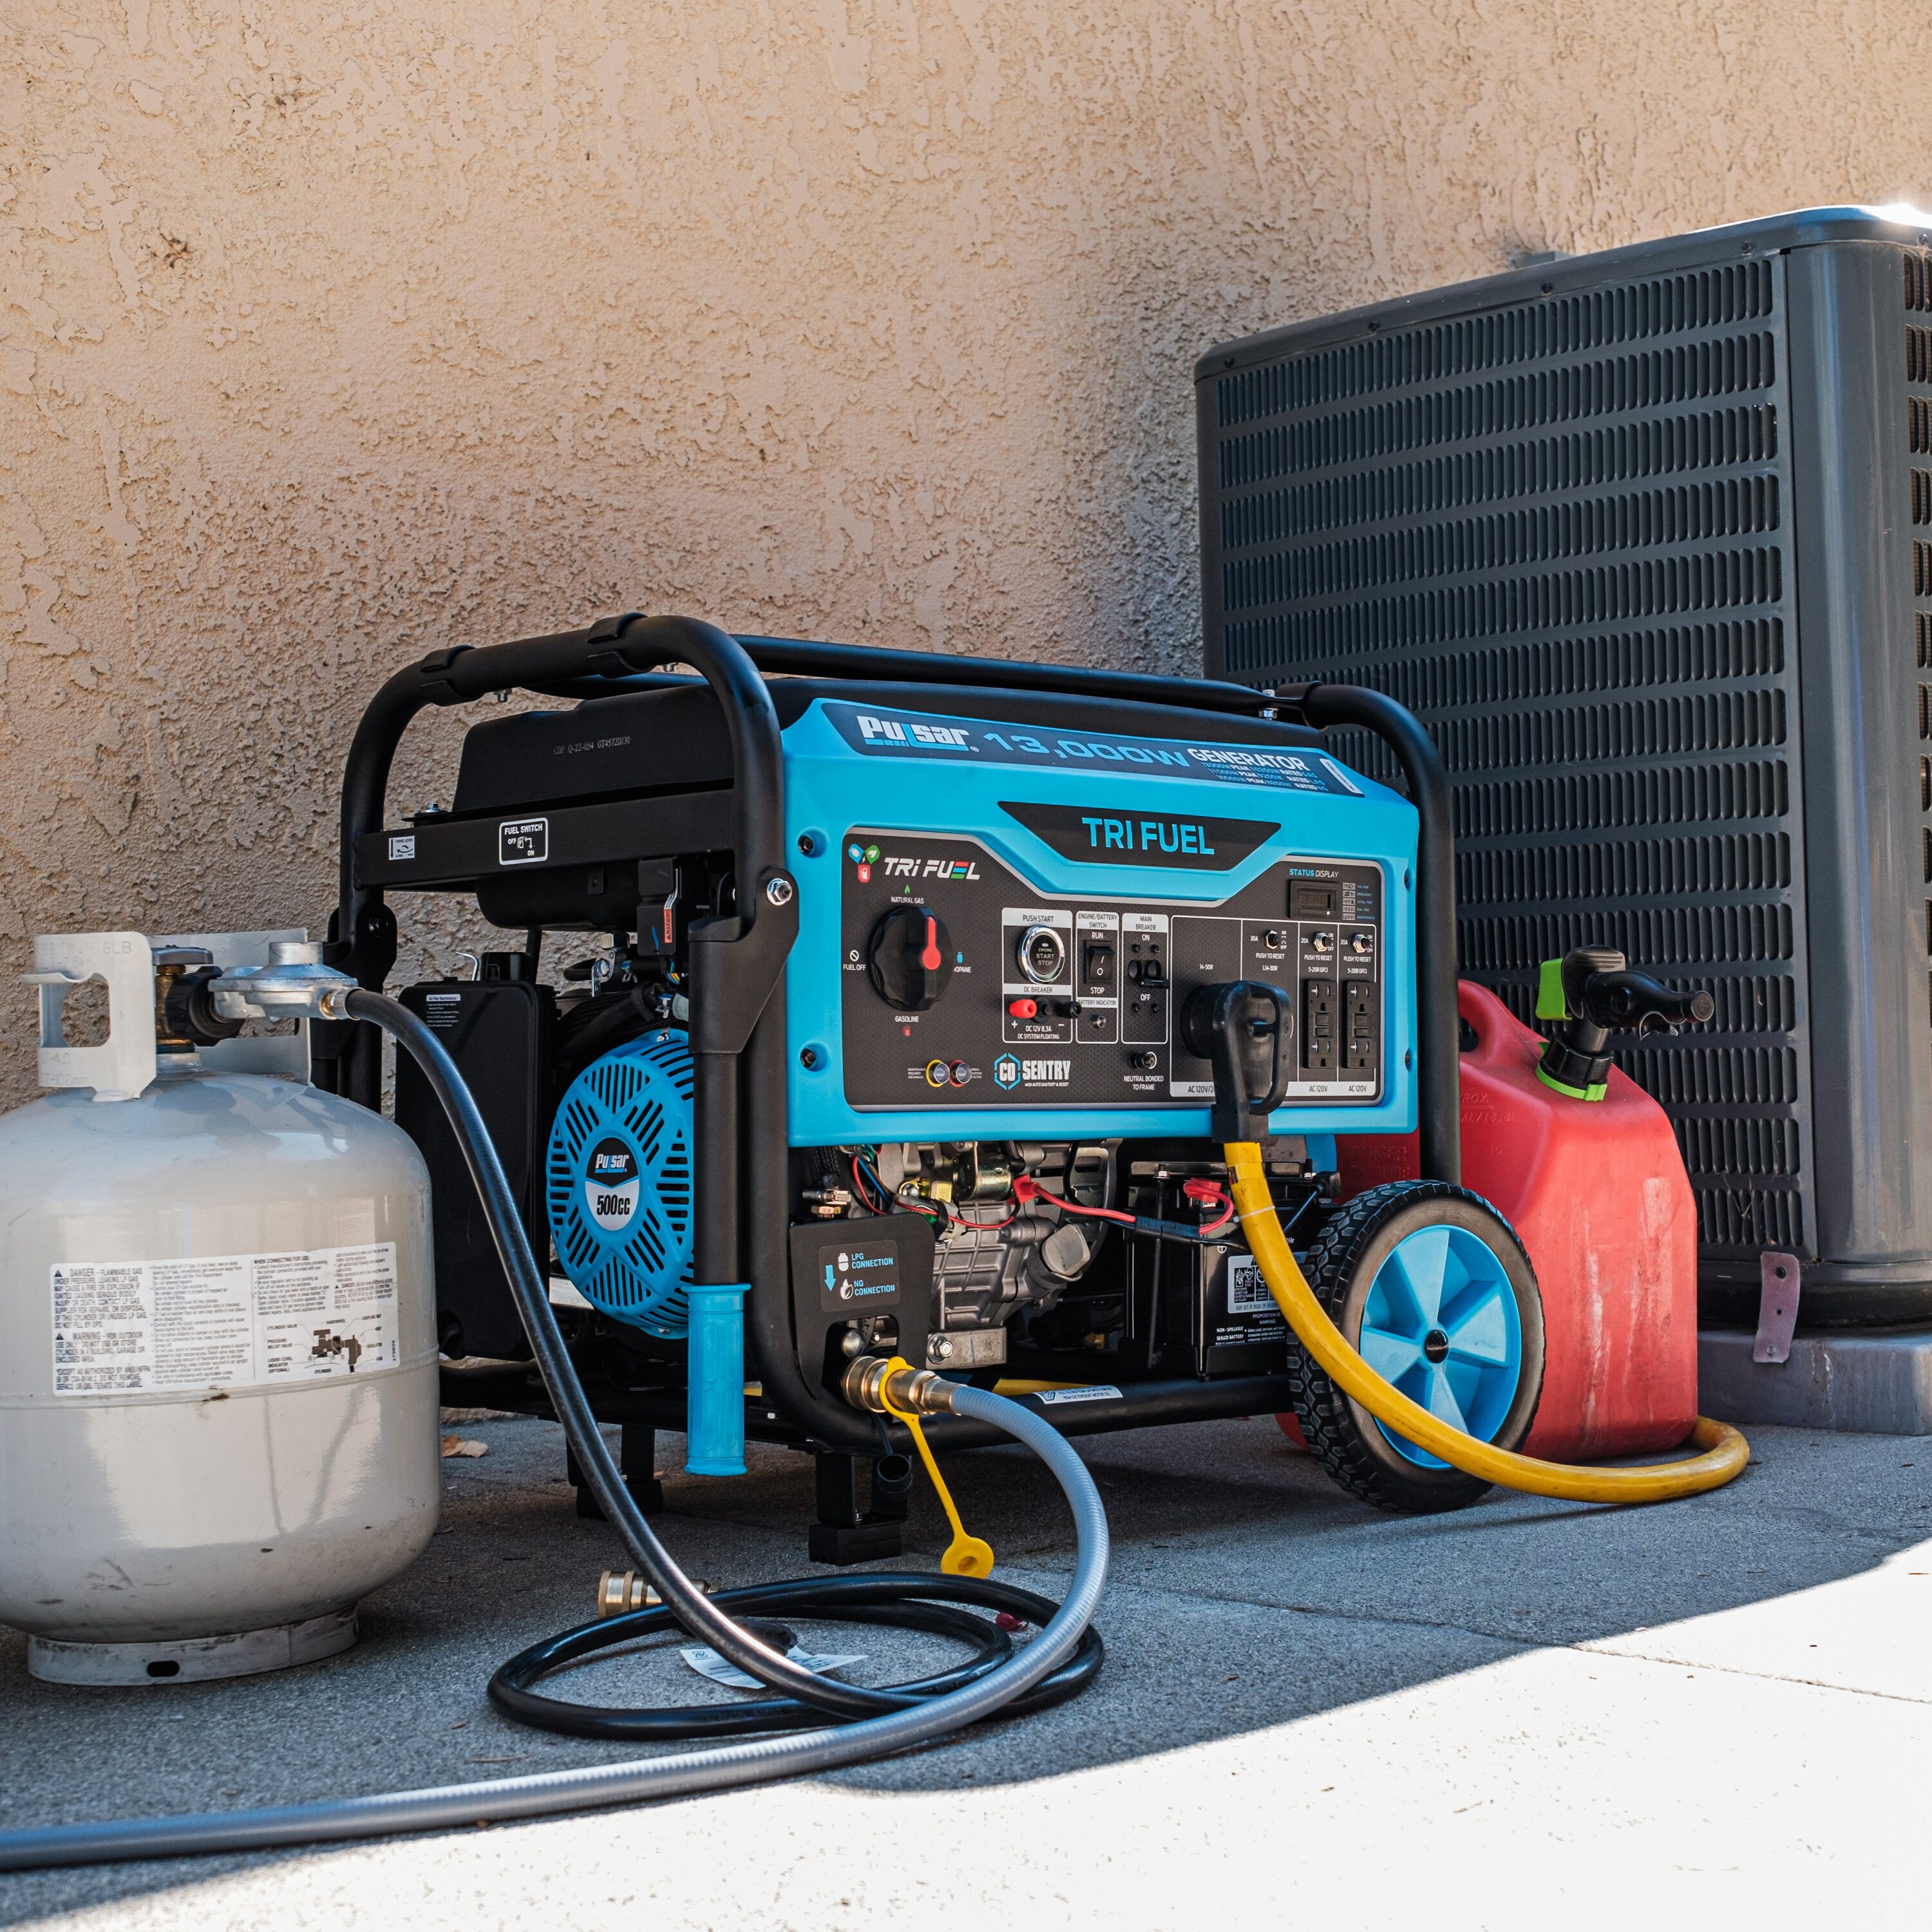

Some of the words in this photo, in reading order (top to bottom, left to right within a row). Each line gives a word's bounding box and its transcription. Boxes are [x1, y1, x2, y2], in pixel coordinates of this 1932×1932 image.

[857, 716, 969, 751] Pulsar
[983, 733, 1190, 767] 13,000W
[1187, 748, 1311, 772] GENERATOR
[505, 827, 519, 835] FUEL
[520, 823, 543, 833] SWITCH
[1081, 817, 1133, 849] TRI
[1140, 821, 1215, 855] FUEL
[922, 860, 980, 880] FUEL
[1289, 869, 1315, 877] STATUS
[1315, 870, 1339, 878] DISPLAY
[999, 1063, 1016, 1081] CO
[1022, 1061, 1071, 1081] SENTRY
[1462, 1093, 1489, 1103] ROX.
[1461, 1112, 1515, 1122] AL/18.8L
[596, 1153, 629, 1169] Pulsar
[596, 1195, 630, 1216] 500cc
[851, 1258, 893, 1269] CONNECTION
[70, 1268, 93, 1276] DANGER
[855, 1284, 895, 1296] CONNECTION
[72, 1332, 100, 1340] WARNING
